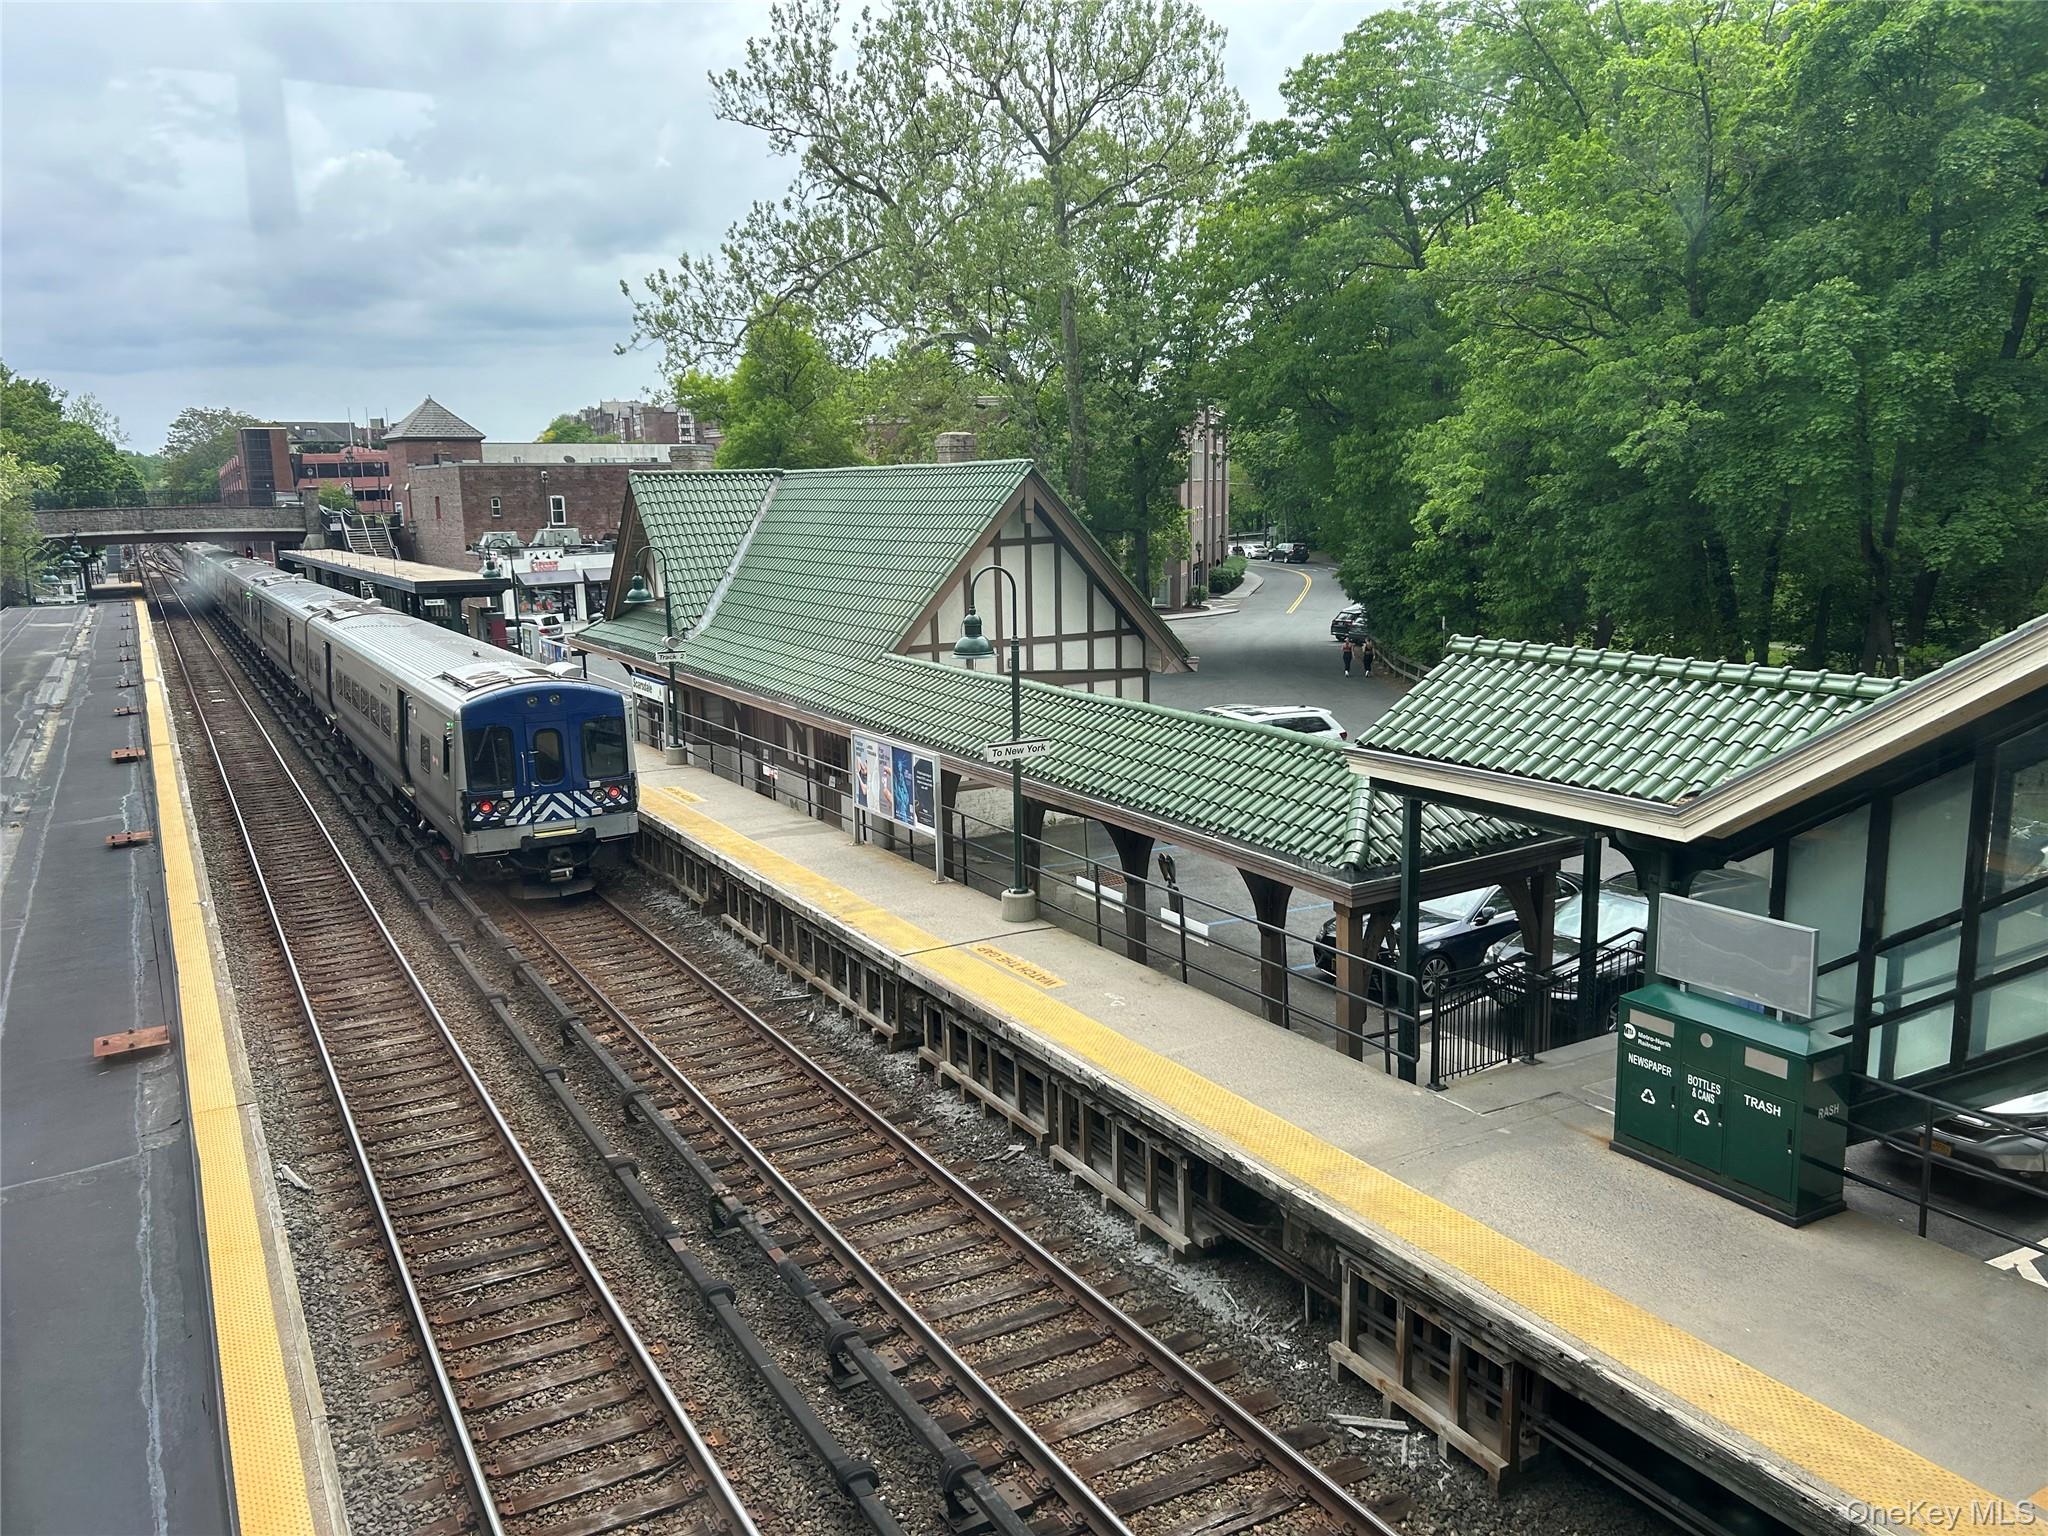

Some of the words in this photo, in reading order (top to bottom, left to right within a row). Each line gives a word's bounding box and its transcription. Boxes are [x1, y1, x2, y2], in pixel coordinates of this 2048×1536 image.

[992, 748, 1003, 757] To
[1005, 747, 1024, 756] New
[1027, 743, 1046, 753] York
[977, 947, 1002, 958] GAP
[996, 956, 1021, 968] THE
[1016, 966, 1057, 986] WATCH
[1637, 1031, 1672, 1048] Metro-North
[1637, 1038, 1661, 1051] Railroad
[1628, 1052, 1672, 1078] NEWSPAPER
[1687, 1074, 1721, 1095] BOTTLES
[1691, 1087, 1697, 1098] &
[1697, 1089, 1715, 1104] CANS
[1743, 1094, 1782, 1117] TRASH
[1818, 1103, 1840, 1119] RASH
